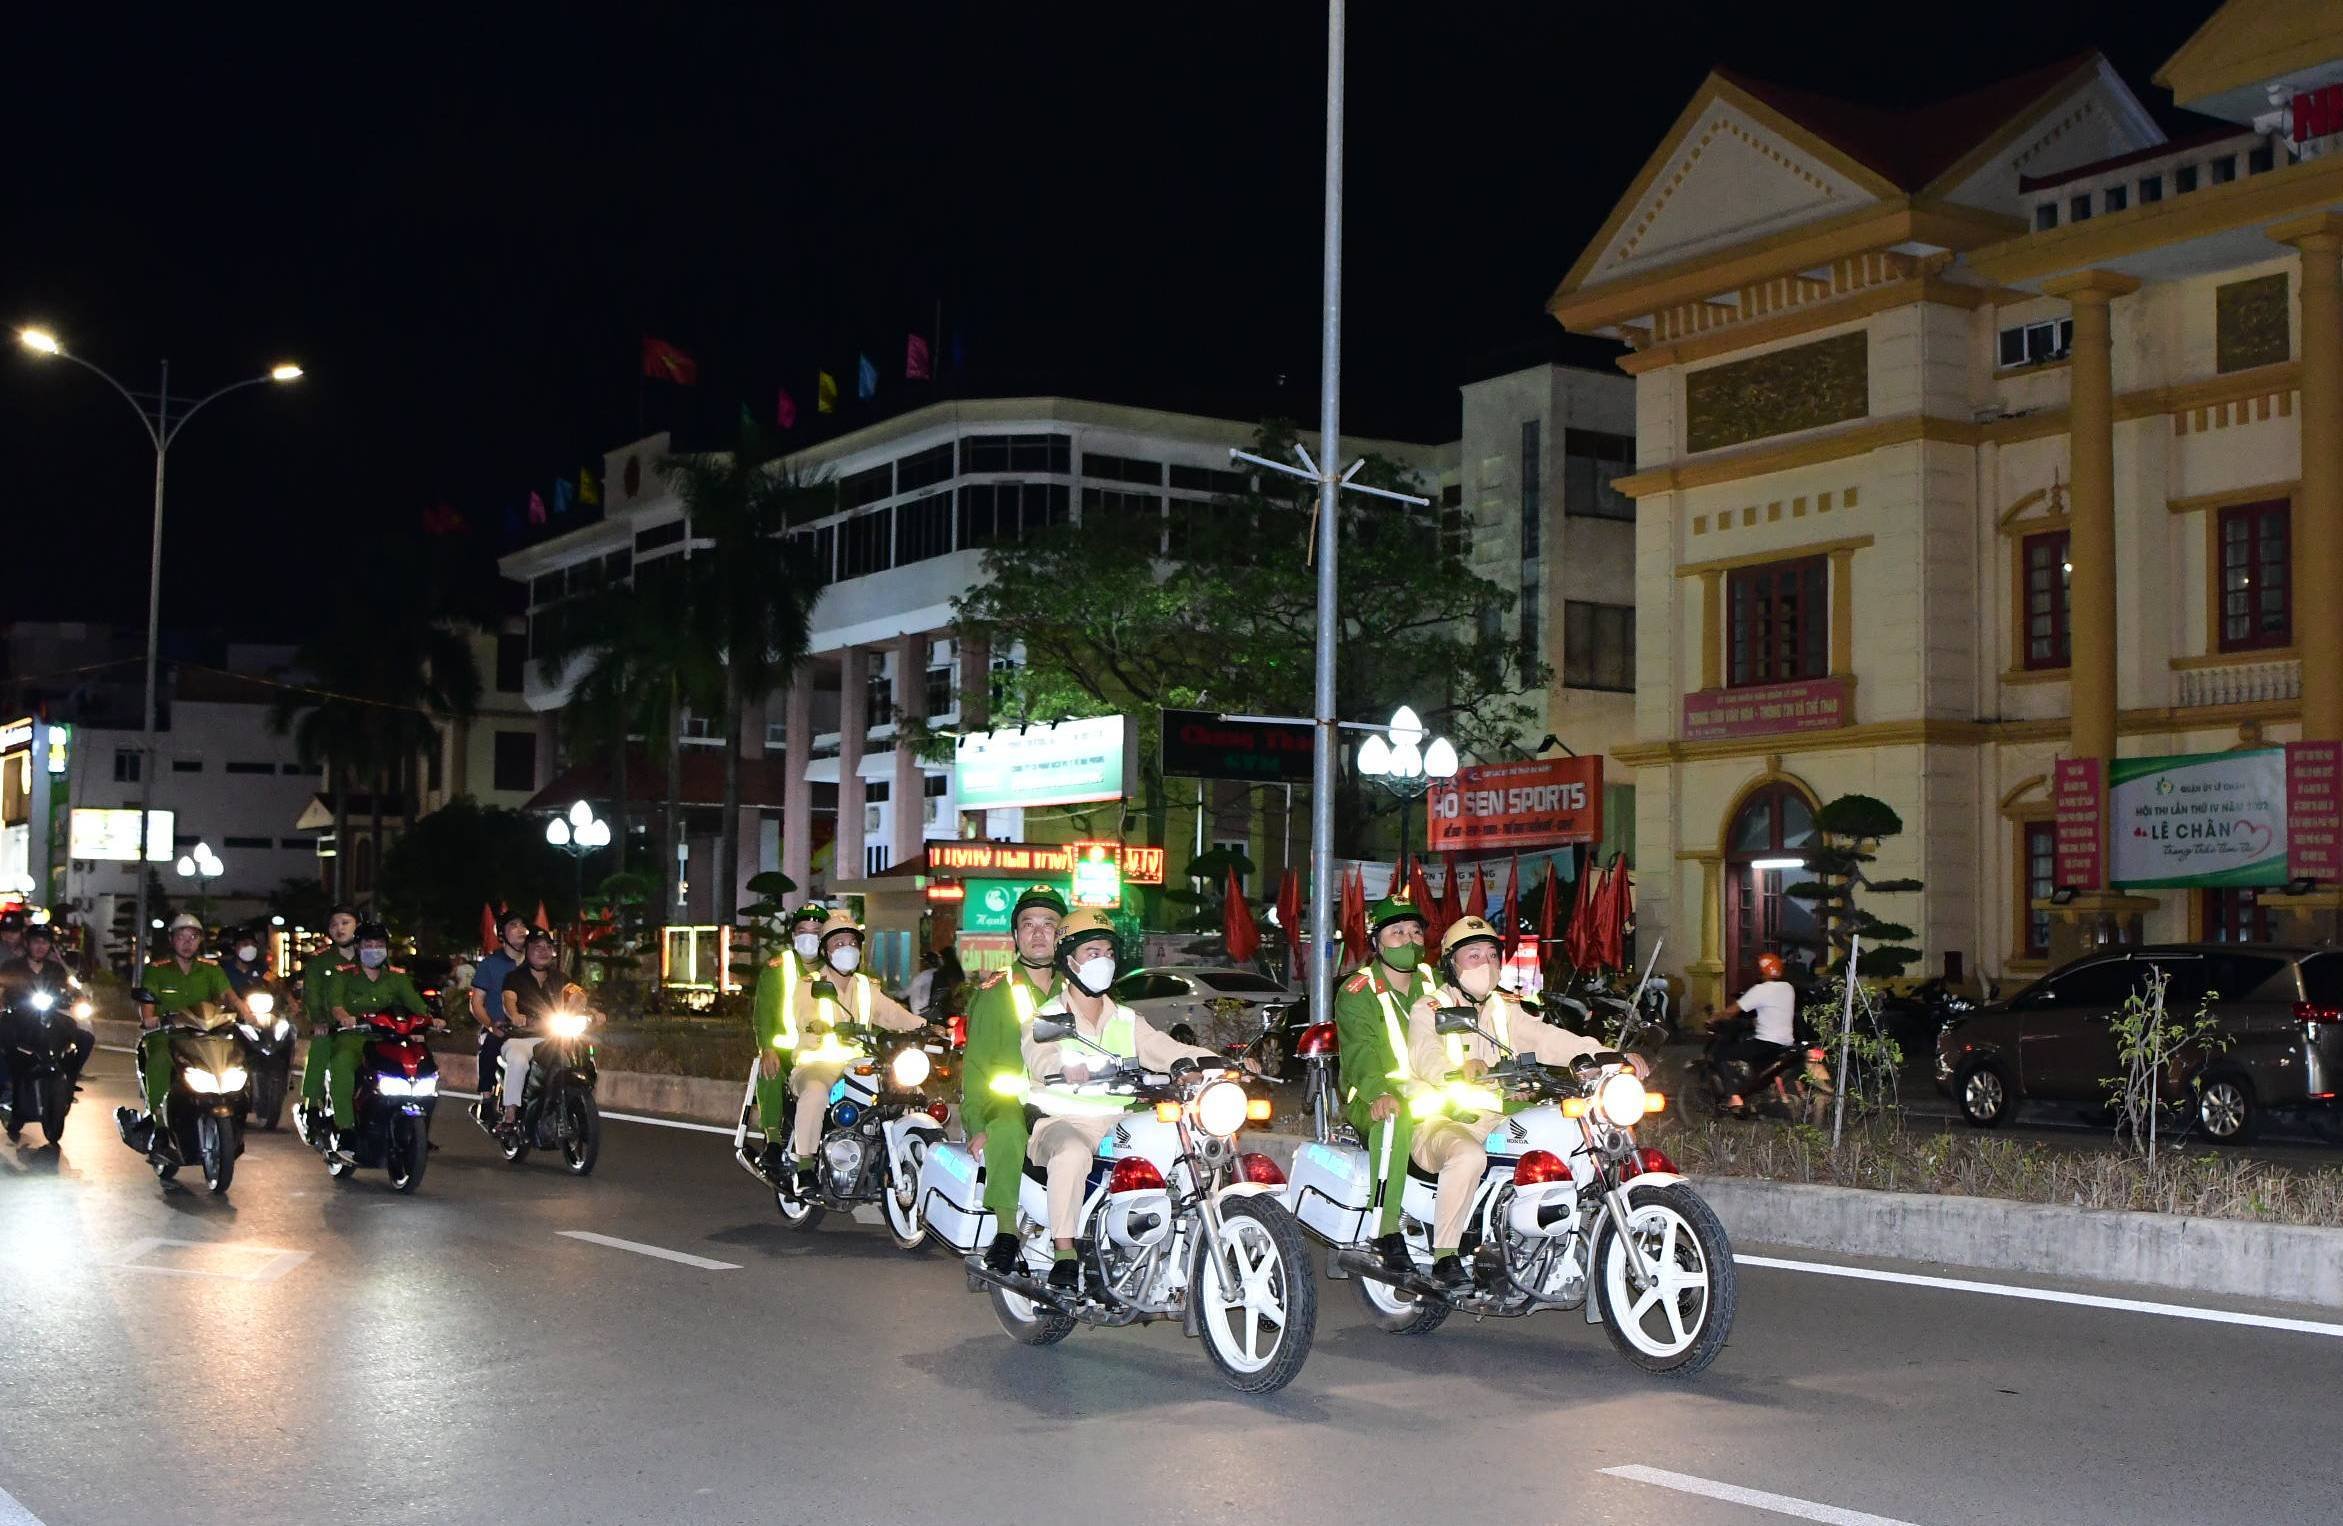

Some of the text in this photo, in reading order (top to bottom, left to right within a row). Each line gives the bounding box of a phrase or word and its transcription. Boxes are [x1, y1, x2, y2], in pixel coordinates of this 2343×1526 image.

[1466, 788, 1504, 817] SEN
[1509, 782, 1586, 813] SPORTS
[2152, 819, 2231, 840] LÊ CHÂN
